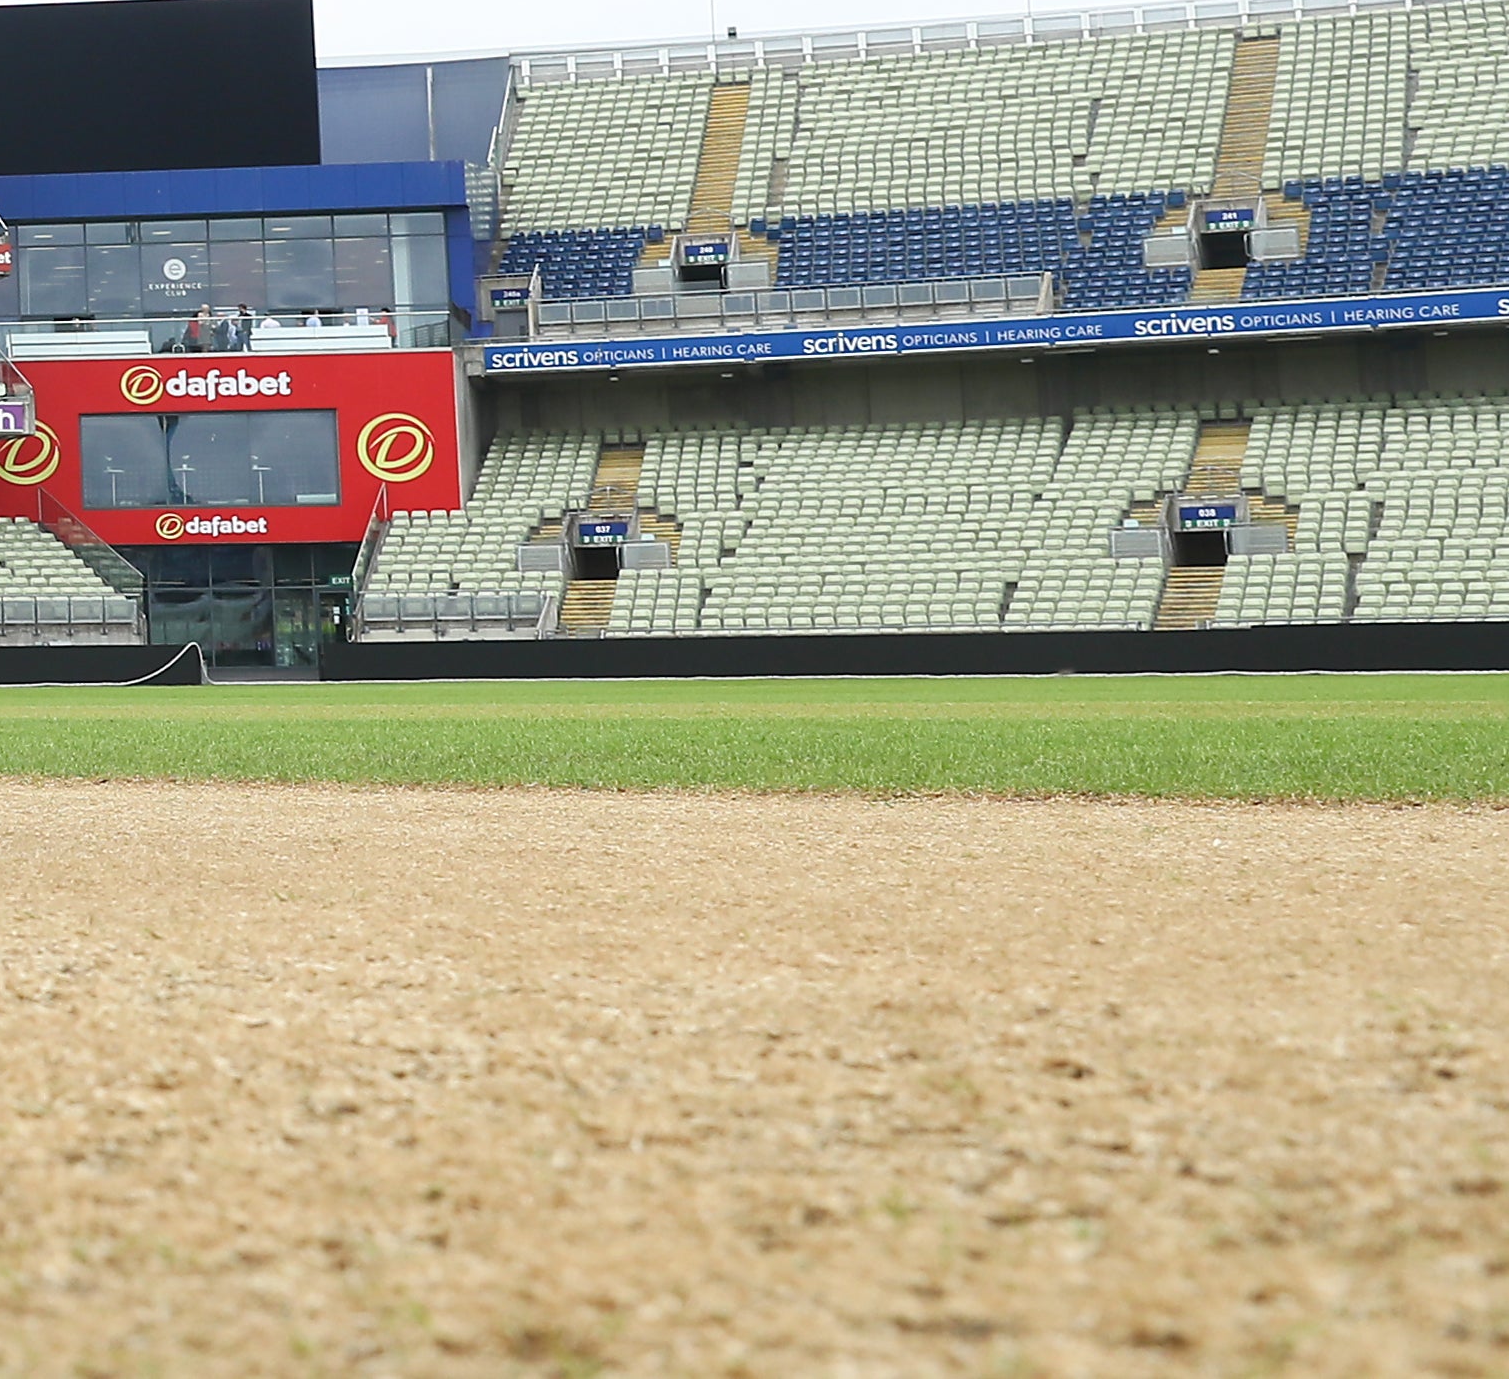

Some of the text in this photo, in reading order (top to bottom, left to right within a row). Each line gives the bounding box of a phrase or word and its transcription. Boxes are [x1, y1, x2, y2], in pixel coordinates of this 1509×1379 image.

[148, 282, 203, 290] EXPERIENCE
[1134, 303, 1460, 336] scrivens OPTICIANS HEARING CARE
[803, 324, 1103, 354] scrivens OPTICIANS HEARING CARE
[492, 342, 772, 368] scrivens OPTICIANS HEARING CARE
[165, 369, 293, 402] dafabet
[1198, 508, 1217, 517] 038
[185, 515, 269, 538] dafabet
